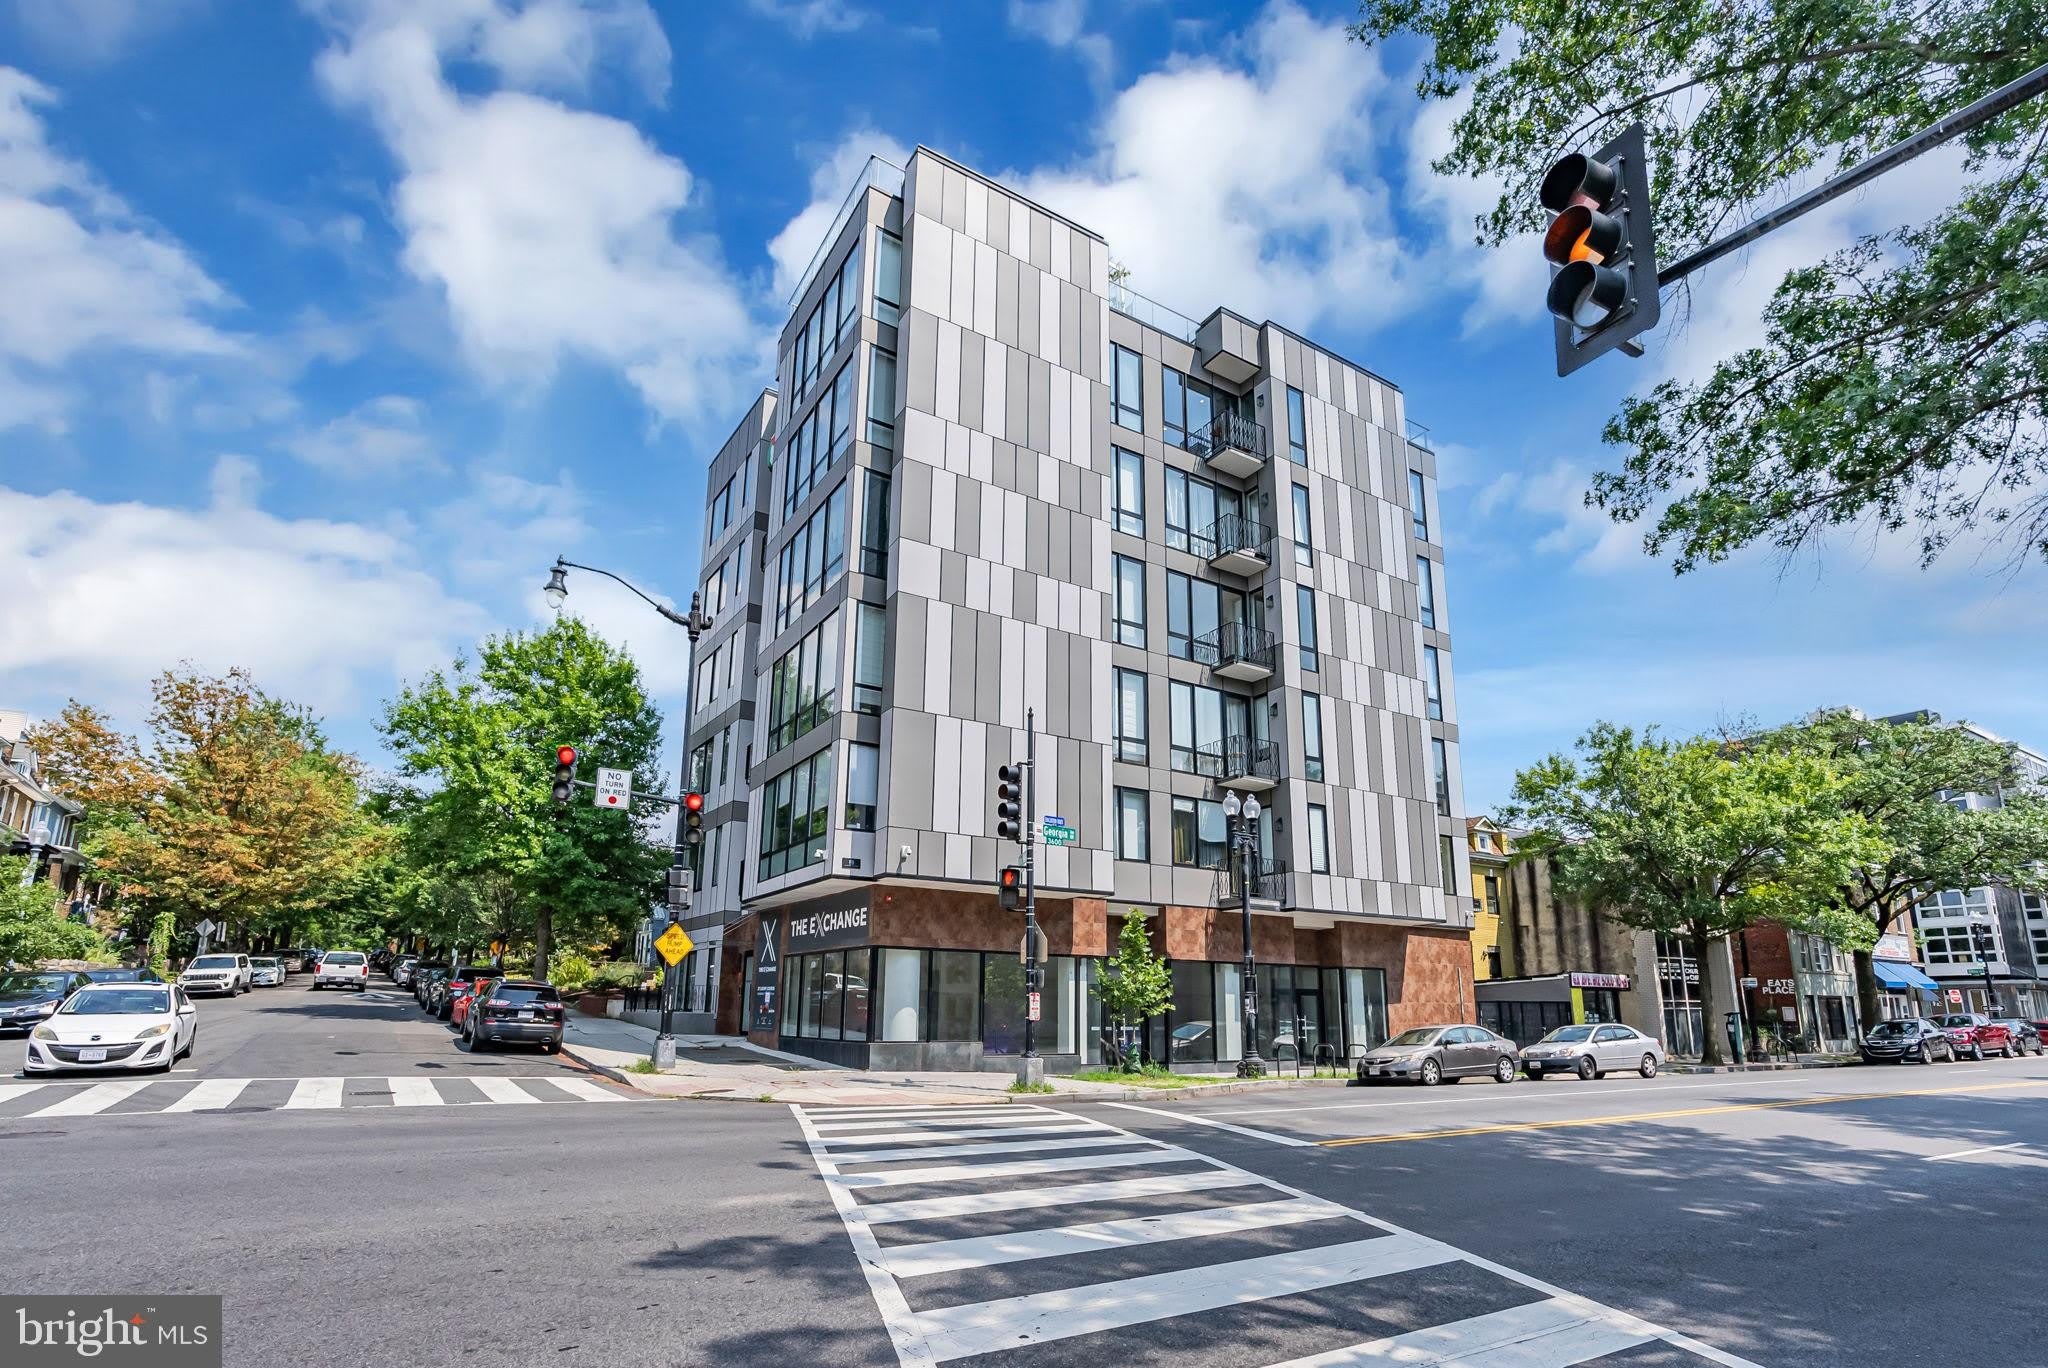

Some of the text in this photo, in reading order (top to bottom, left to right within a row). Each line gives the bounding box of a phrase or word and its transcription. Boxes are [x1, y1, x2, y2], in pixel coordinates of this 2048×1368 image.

[608, 772, 622, 780] NO
[1044, 826, 1068, 839] Georgia
[1047, 838, 1063, 846] 3600
[791, 907, 868, 938] THE EXCHANGE
[1767, 979, 1795, 987] EATS
[1762, 986, 1795, 994] PLACE
